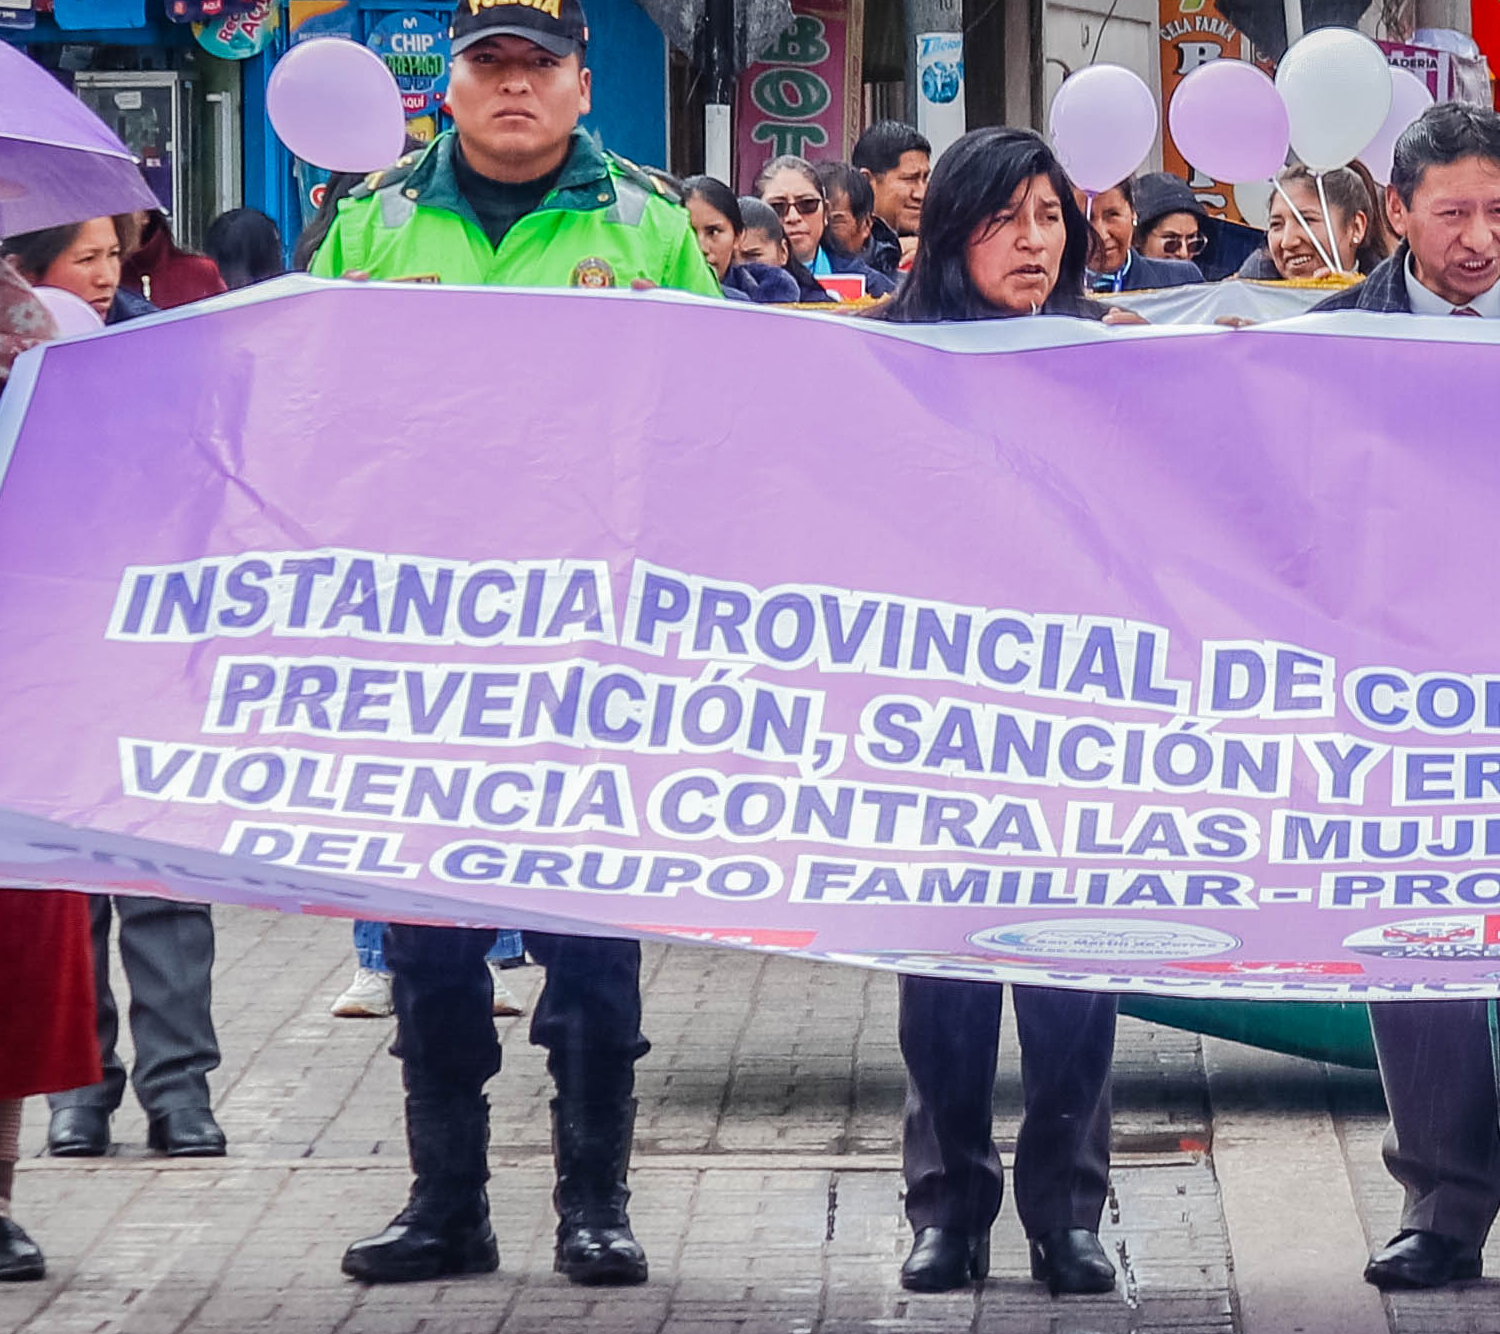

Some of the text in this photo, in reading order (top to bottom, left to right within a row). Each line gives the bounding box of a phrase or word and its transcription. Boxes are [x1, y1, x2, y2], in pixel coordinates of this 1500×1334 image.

[391, 32, 434, 53] CHIP
[1161, 16, 1234, 42] CELA FARMA
[120, 556, 606, 636] INSTANCIA
[635, 571, 1180, 707] PROVINCIAL
[1210, 647, 1325, 713] DE
[215, 661, 833, 768] PREVENCIÓN,
[866, 702, 1281, 794] SANCIÓN
[1316, 738, 1373, 799] Y
[131, 743, 624, 828] VIOLENCIA
[658, 775, 1046, 850] CONTRA
[1076, 806, 1249, 858] LAS
[234, 827, 411, 874] DEL
[443, 843, 772, 898] GRUPO
[801, 861, 1245, 907] FAMILIAR
